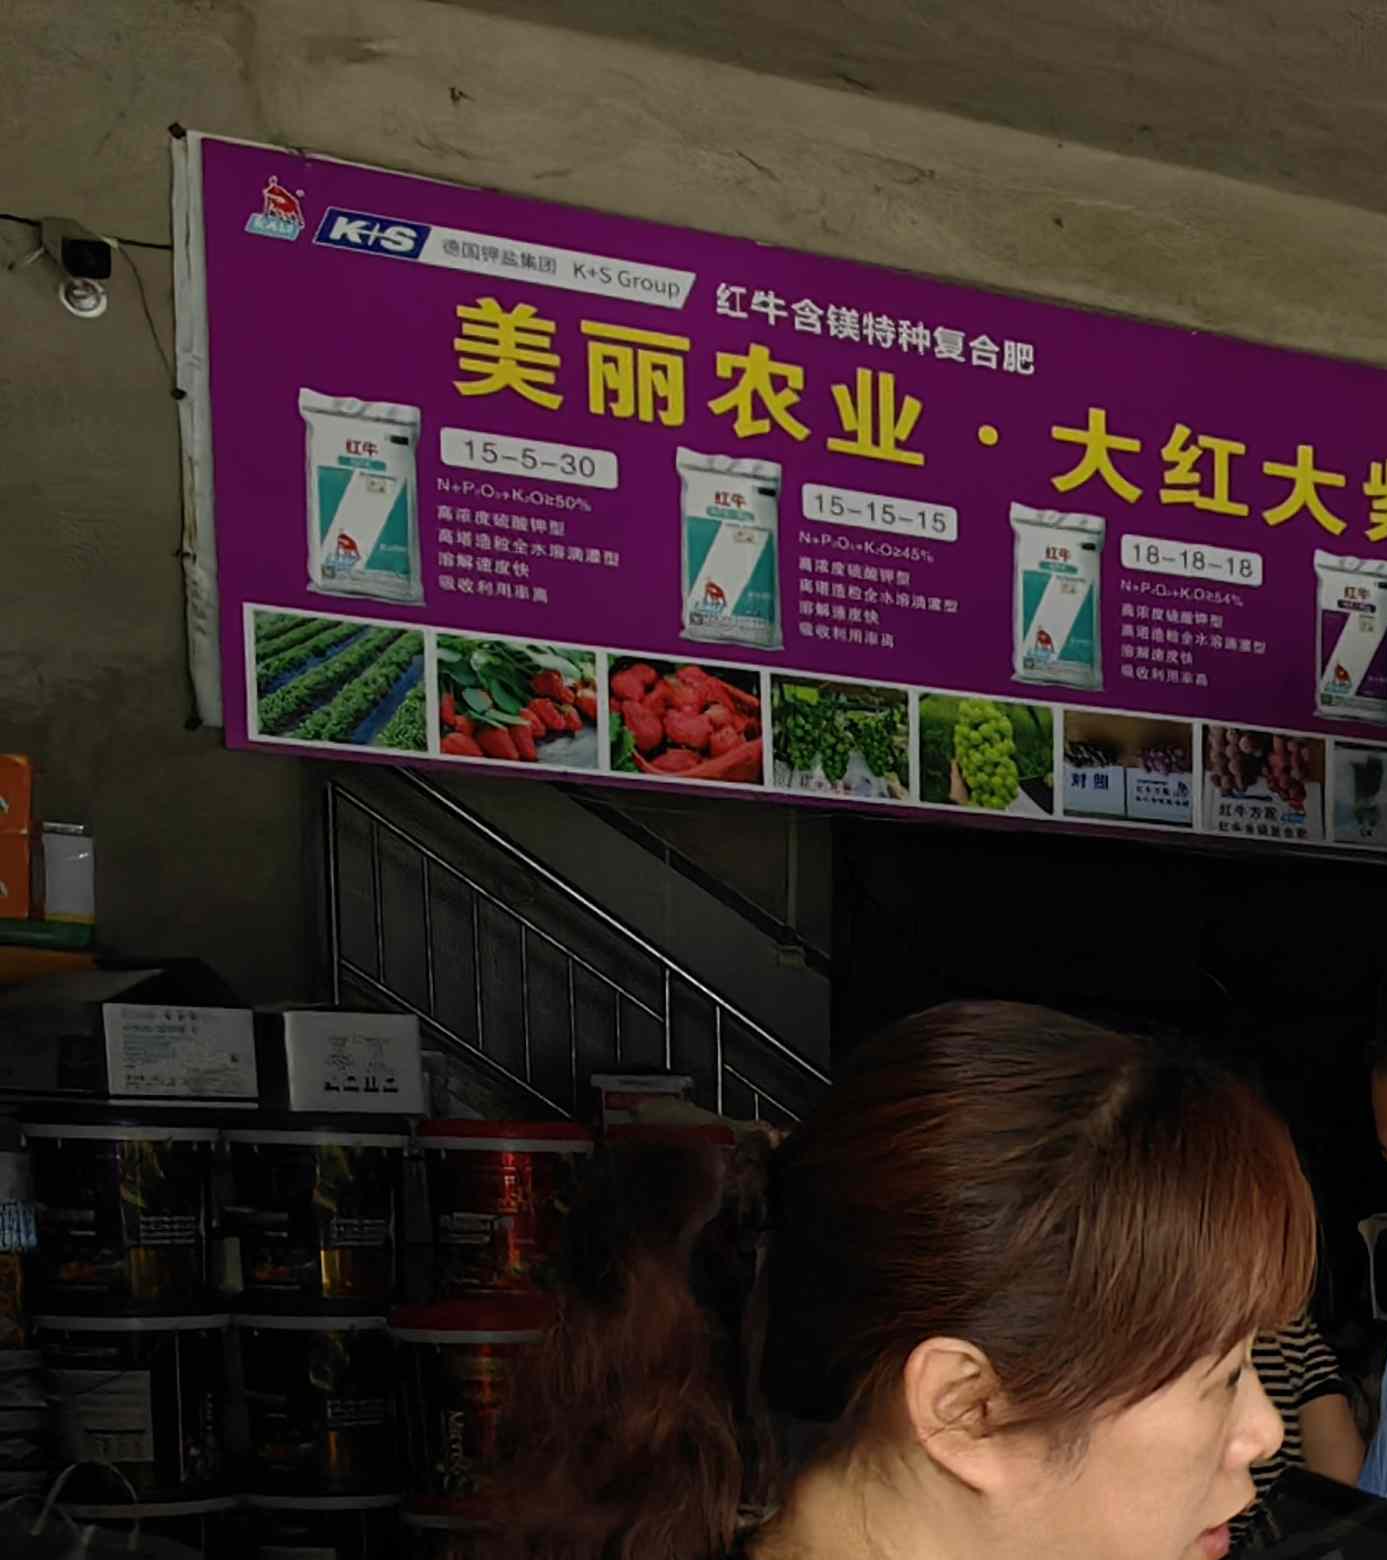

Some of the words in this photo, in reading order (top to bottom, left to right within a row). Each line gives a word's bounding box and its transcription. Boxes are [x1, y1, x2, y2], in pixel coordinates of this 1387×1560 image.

[329, 216, 417, 255] K+S
[573, 260, 613, 285] K+S
[617, 269, 682, 300] Group
[715, 282, 1035, 376] 红牛含镁特种复合肥
[463, 439, 597, 478] 15-5-30
[813, 493, 947, 534] 15-15-15
[1132, 543, 1254, 578] 18-18-18
